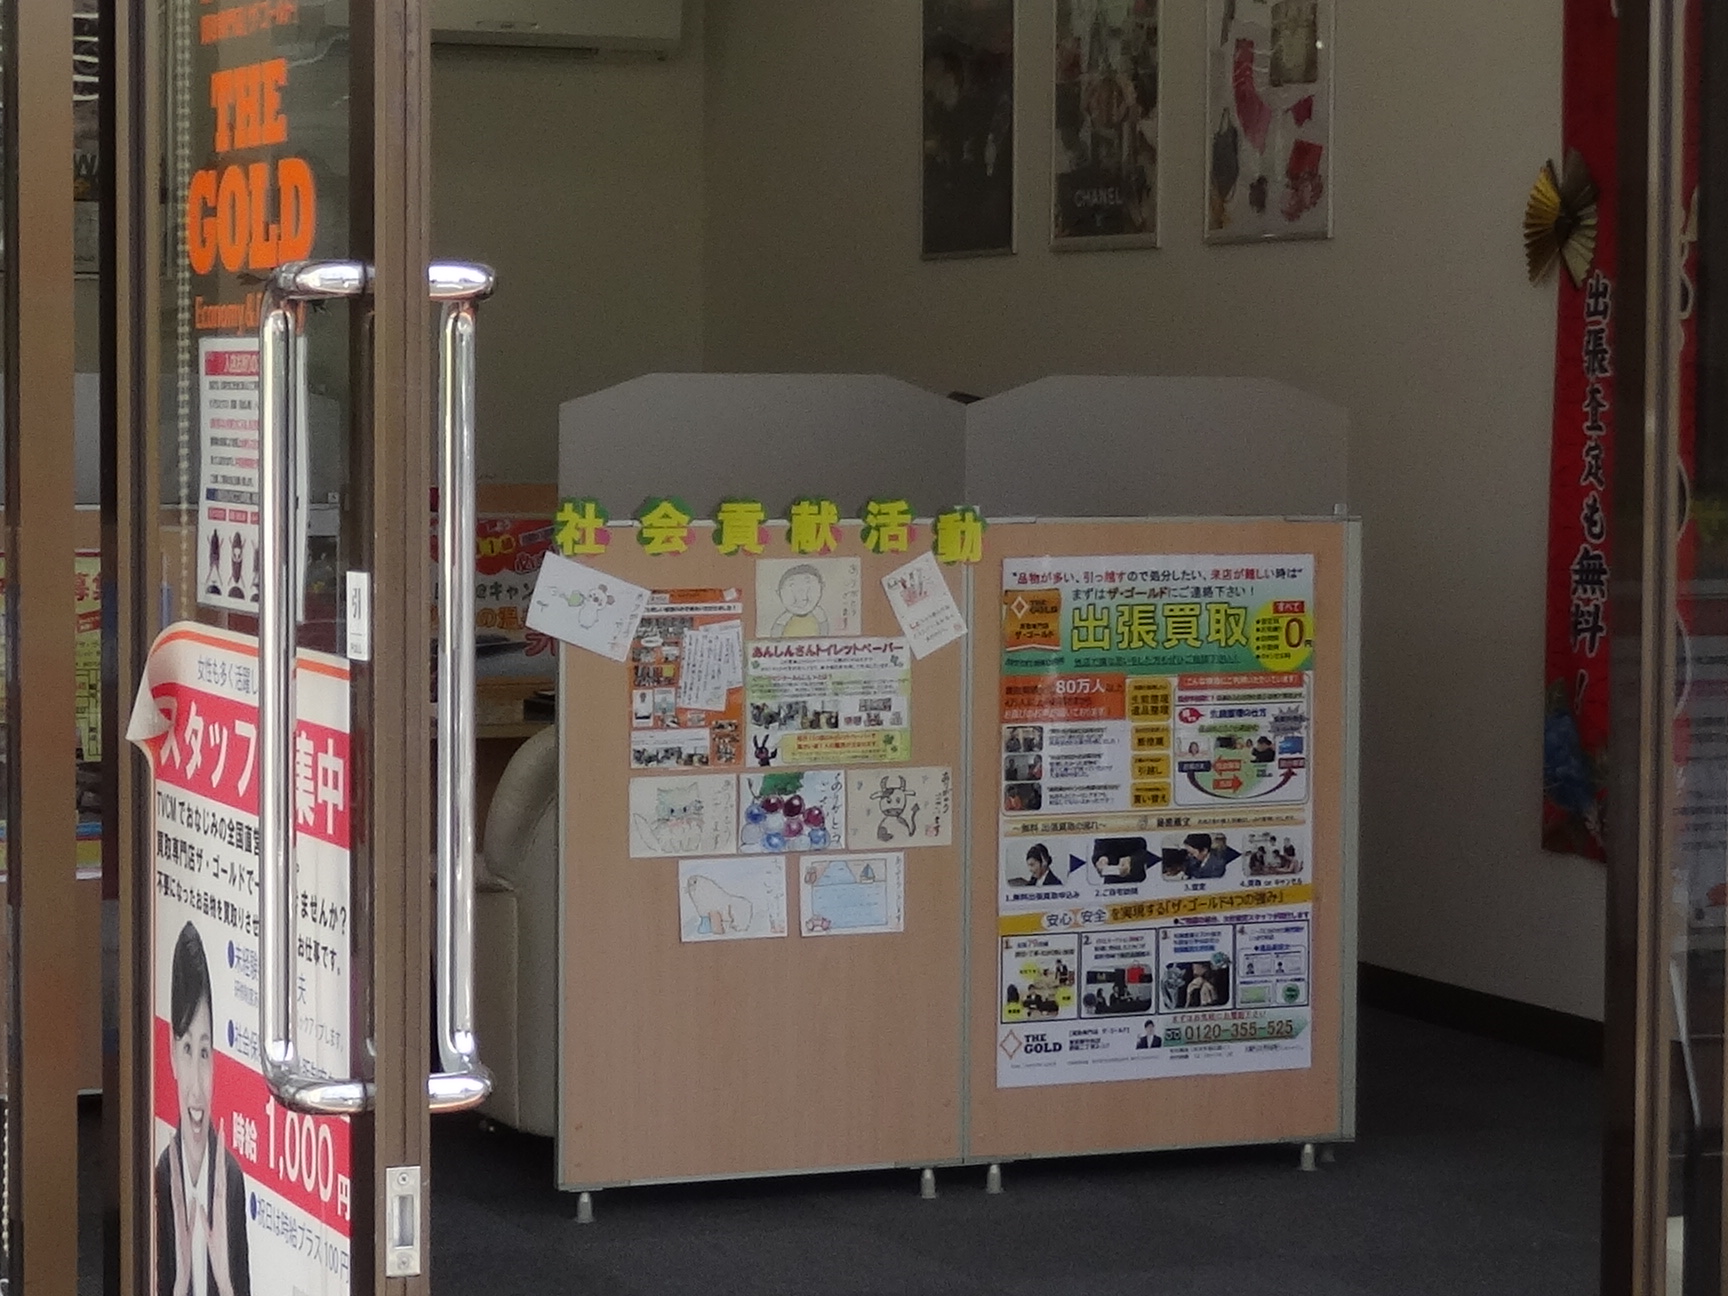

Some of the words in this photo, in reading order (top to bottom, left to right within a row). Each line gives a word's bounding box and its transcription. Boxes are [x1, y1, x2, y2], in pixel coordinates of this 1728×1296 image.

[210, 57, 288, 154] THE
[186, 157, 317, 276] GOLD
[556, 501, 983, 563] 社会貢献活動
[1070, 602, 1250, 652] 出張買取
[1046, 912, 1073, 928] 安心
[1080, 908, 1107, 924] 安全
[1024, 1034, 1047, 1043] THE
[1024, 1042, 1063, 1054] GOLD
[1184, 1019, 1293, 1041] 0120-355-525
[233, 1110, 258, 1164] 時給
